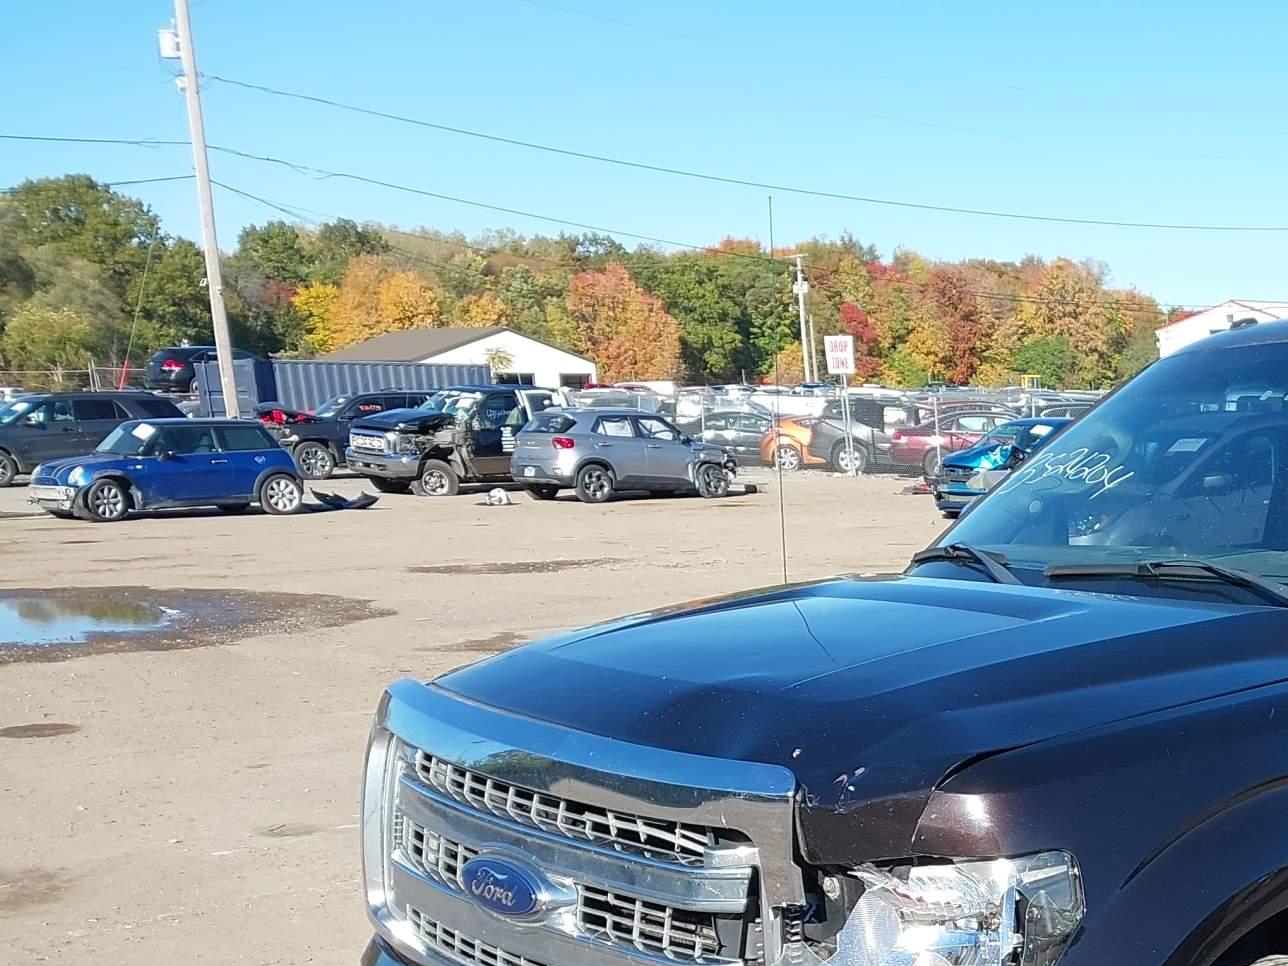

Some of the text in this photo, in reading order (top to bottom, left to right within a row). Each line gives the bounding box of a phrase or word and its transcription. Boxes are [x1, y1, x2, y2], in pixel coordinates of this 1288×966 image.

[828, 341, 849, 353] DROP
[832, 356, 850, 369] ZONE
[471, 867, 518, 907] Ford
